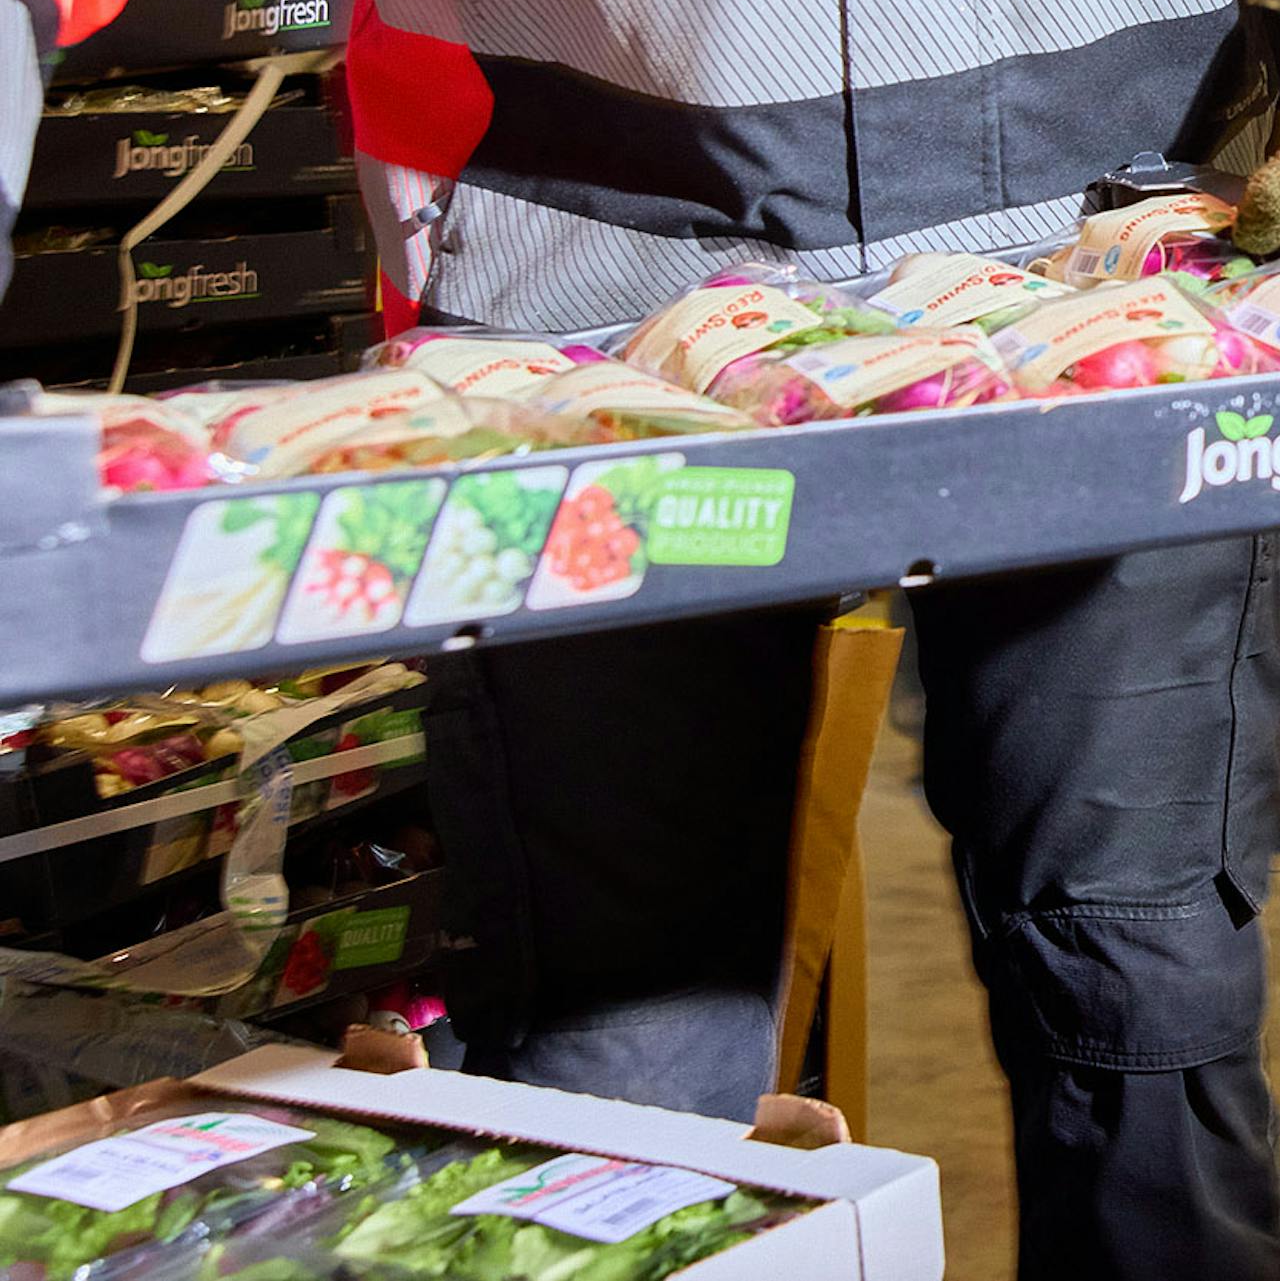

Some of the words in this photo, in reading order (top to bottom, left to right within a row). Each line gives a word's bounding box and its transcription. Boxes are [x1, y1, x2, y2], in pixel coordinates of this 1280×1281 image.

[118, 261, 259, 310] ongfresh
[657, 494, 783, 529] QUALITY
[341, 923, 405, 946] QUALITY
